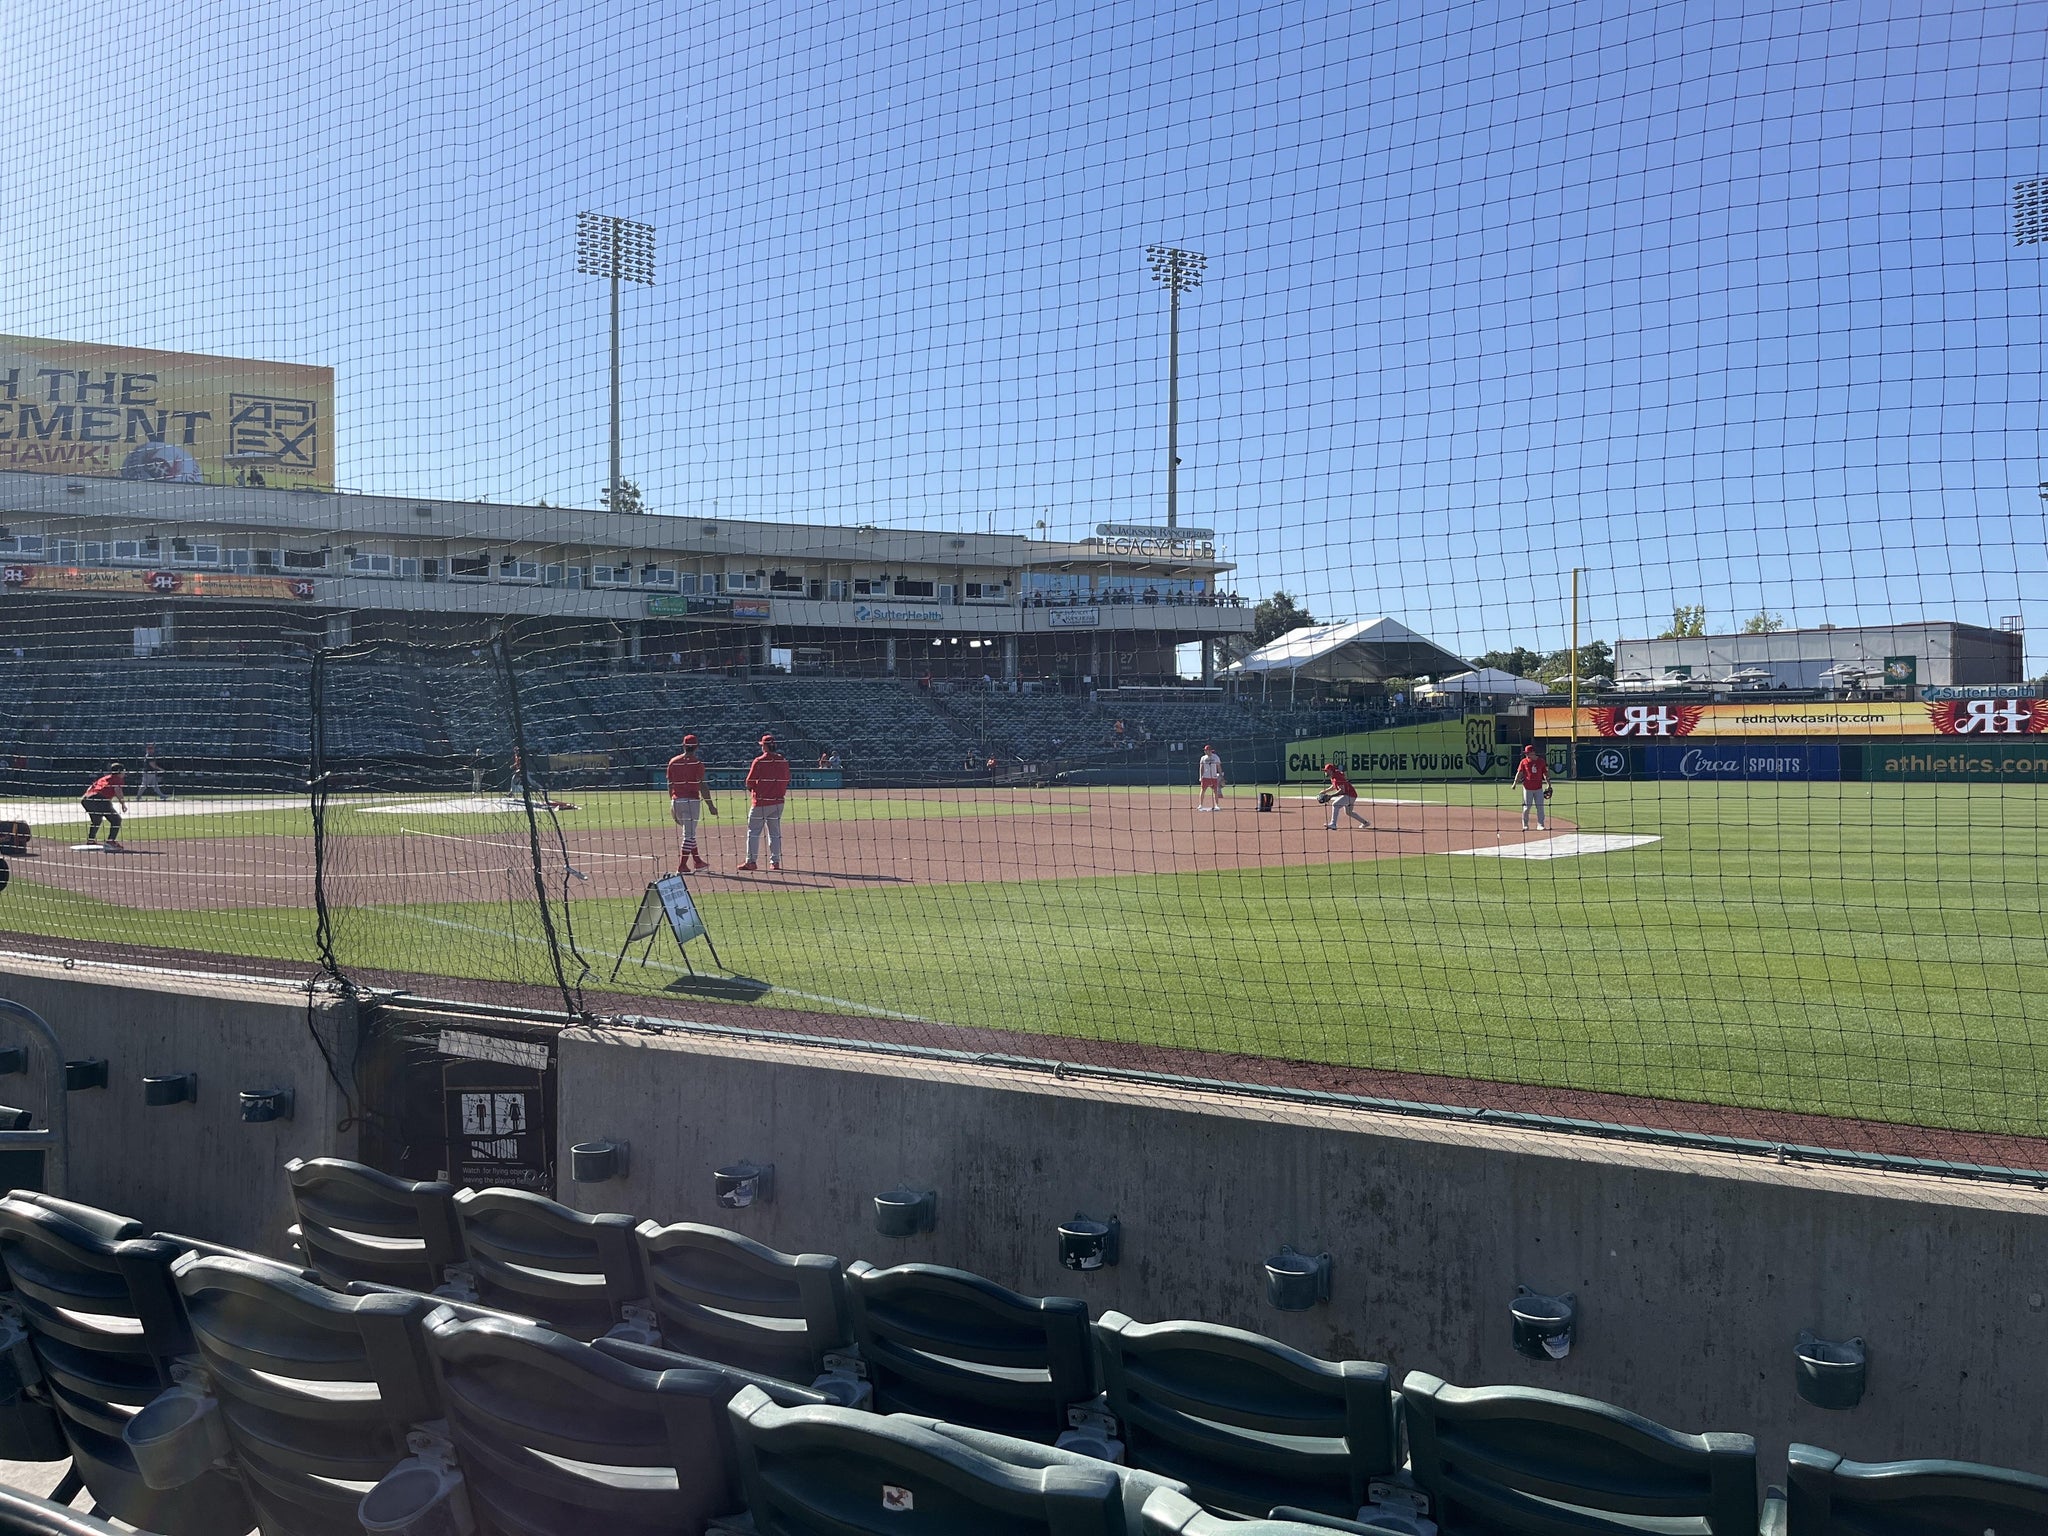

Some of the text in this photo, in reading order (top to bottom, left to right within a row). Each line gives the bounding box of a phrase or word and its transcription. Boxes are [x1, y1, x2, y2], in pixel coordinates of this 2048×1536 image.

[37, 368, 158, 405] THE
[1118, 527, 1207, 538] JACKSON RANCHERIA
[1096, 537, 1215, 559] LEGACY CLUB
[1120, 653, 1133, 664] 27
[1735, 714, 1885, 724] redhawkcasino.com
[1466, 718, 1494, 754] 811
[1289, 753, 1325, 772] CALL
[1351, 754, 1408, 771] BEFORE
[1411, 754, 1438, 771] YOU
[1441, 754, 1463, 770] DIG
[1601, 756, 1619, 769] 42
[1680, 749, 1800, 777] Circa SPORTS
[1884, 754, 2048, 773] athletics.com
[471, 1139, 518, 1159] CAUTION!
[462, 1176, 484, 1184] leaving
[484, 1176, 494, 1184] the
[494, 1177, 516, 1186] playing
[492, 1167, 508, 1176] flying
[510, 1168, 530, 1176] object
